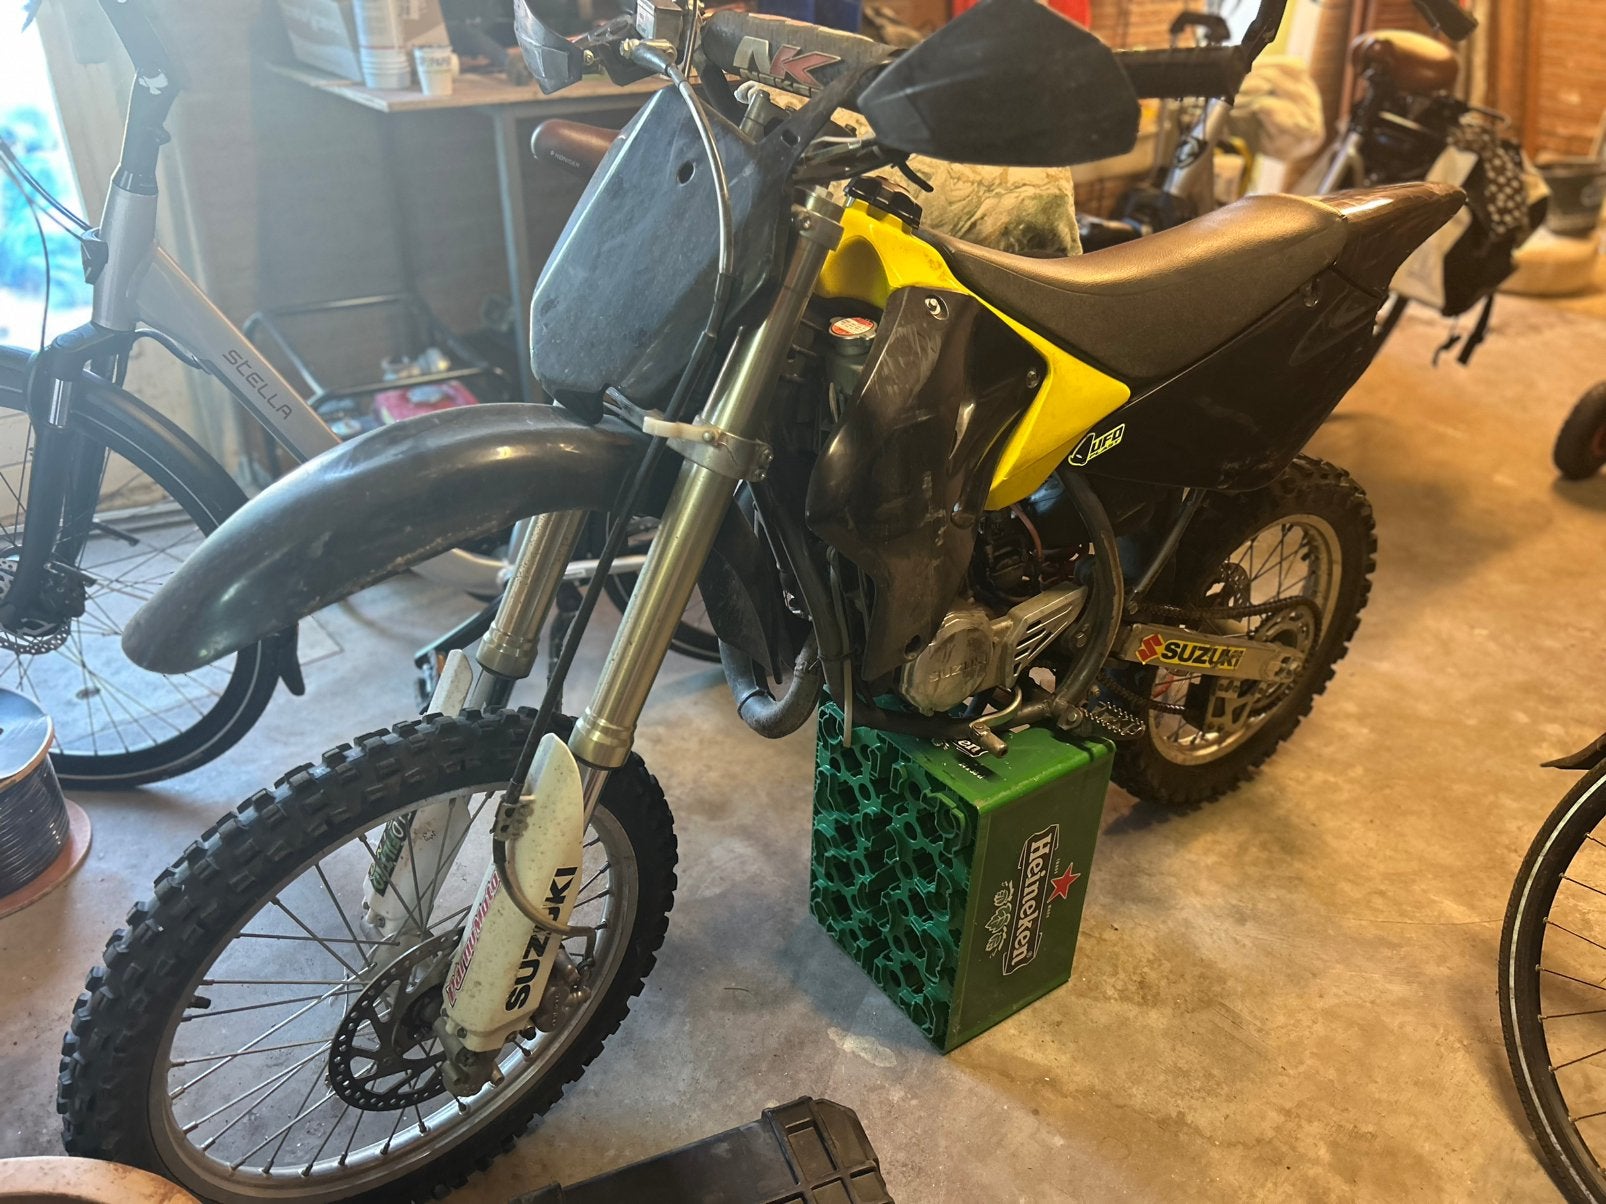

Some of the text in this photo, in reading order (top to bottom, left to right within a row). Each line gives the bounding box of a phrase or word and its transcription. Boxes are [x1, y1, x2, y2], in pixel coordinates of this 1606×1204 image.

[222, 349, 293, 420] STELLA
[1090, 427, 1123, 453] UFO
[1160, 641, 1244, 668] SUZUKI
[1011, 833, 1053, 966] Heineken
